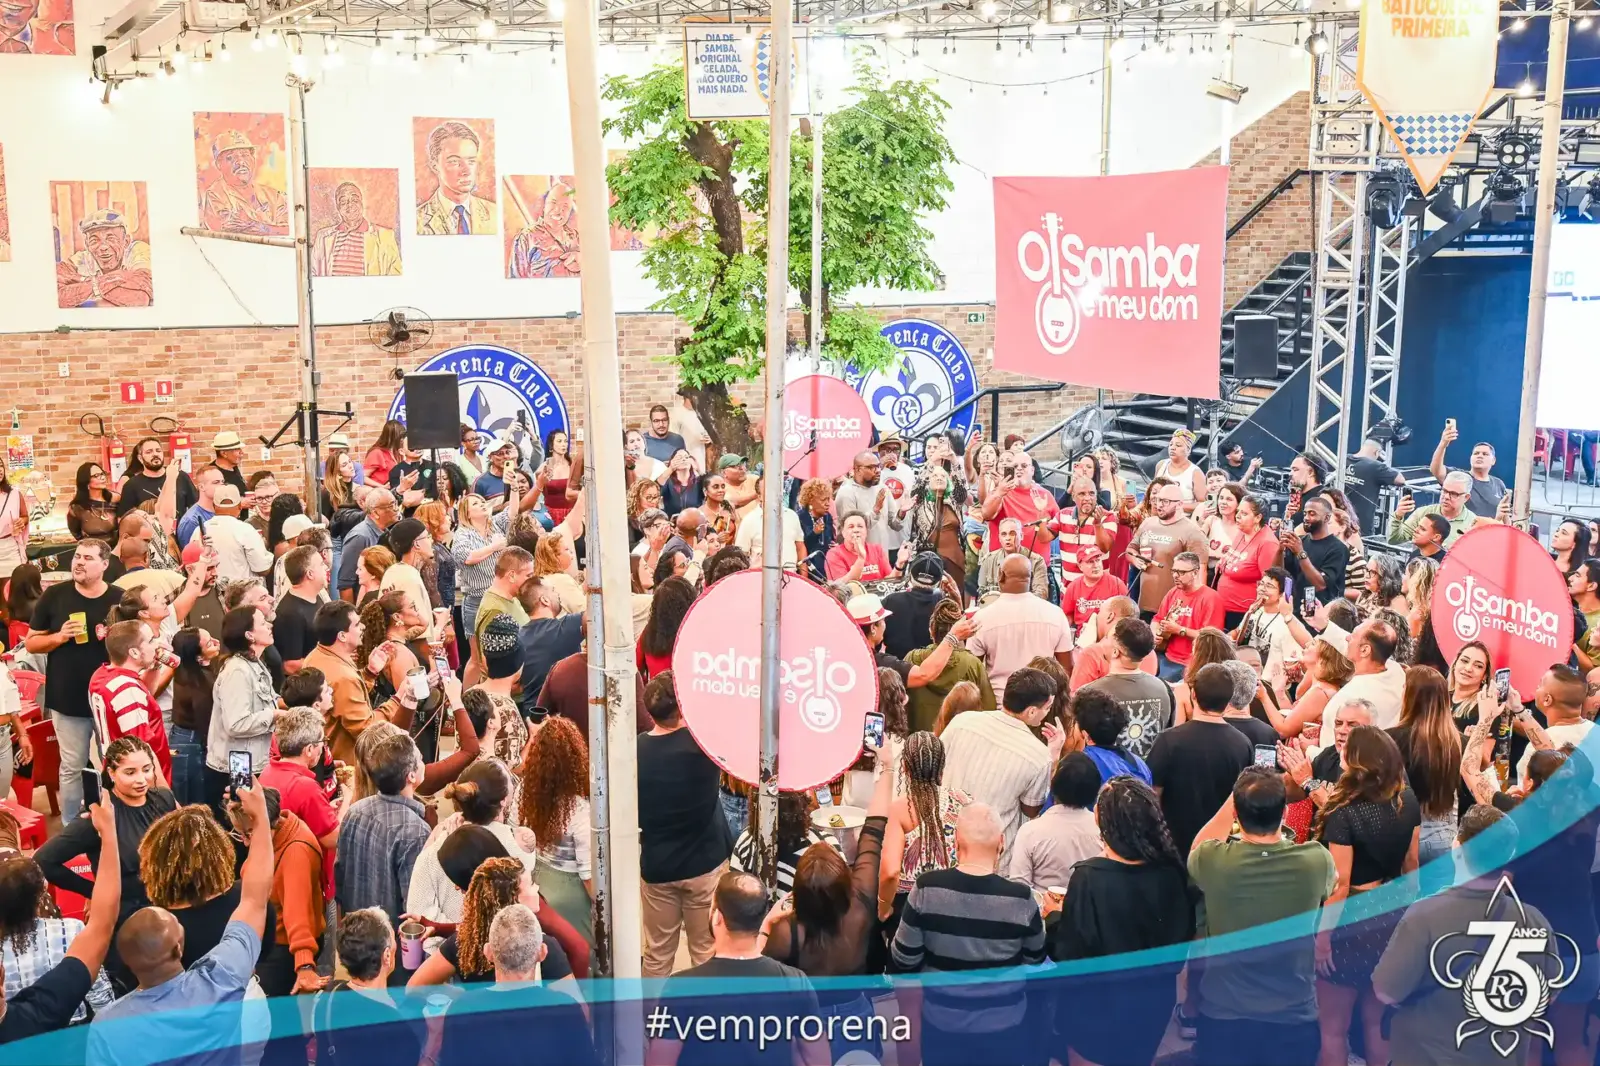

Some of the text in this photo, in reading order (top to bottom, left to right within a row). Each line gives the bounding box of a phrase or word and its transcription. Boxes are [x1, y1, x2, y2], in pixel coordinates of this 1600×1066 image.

[1392, 17, 1470, 38] PRIMEIRA
[705, 33, 734, 42] DIA DE
[704, 43, 737, 53] SAMBA,
[700, 54, 742, 63] ORIGINAL
[716, 74, 748, 83] QUERO
[698, 84, 747, 94] MAIS NADA.
[1060, 231, 1200, 289] Samba
[1099, 293, 1147, 321] meu
[1149, 288, 1198, 321] dom
[931, 333, 966, 385] Clube
[508, 362, 554, 419] Clube
[795, 414, 861, 431] Samba
[836, 429, 861, 439] dom
[1471, 586, 1559, 634] Samba
[1492, 618, 1523, 637] meu
[1524, 624, 1558, 649] dom
[70, 864, 92, 875] BRAHM
